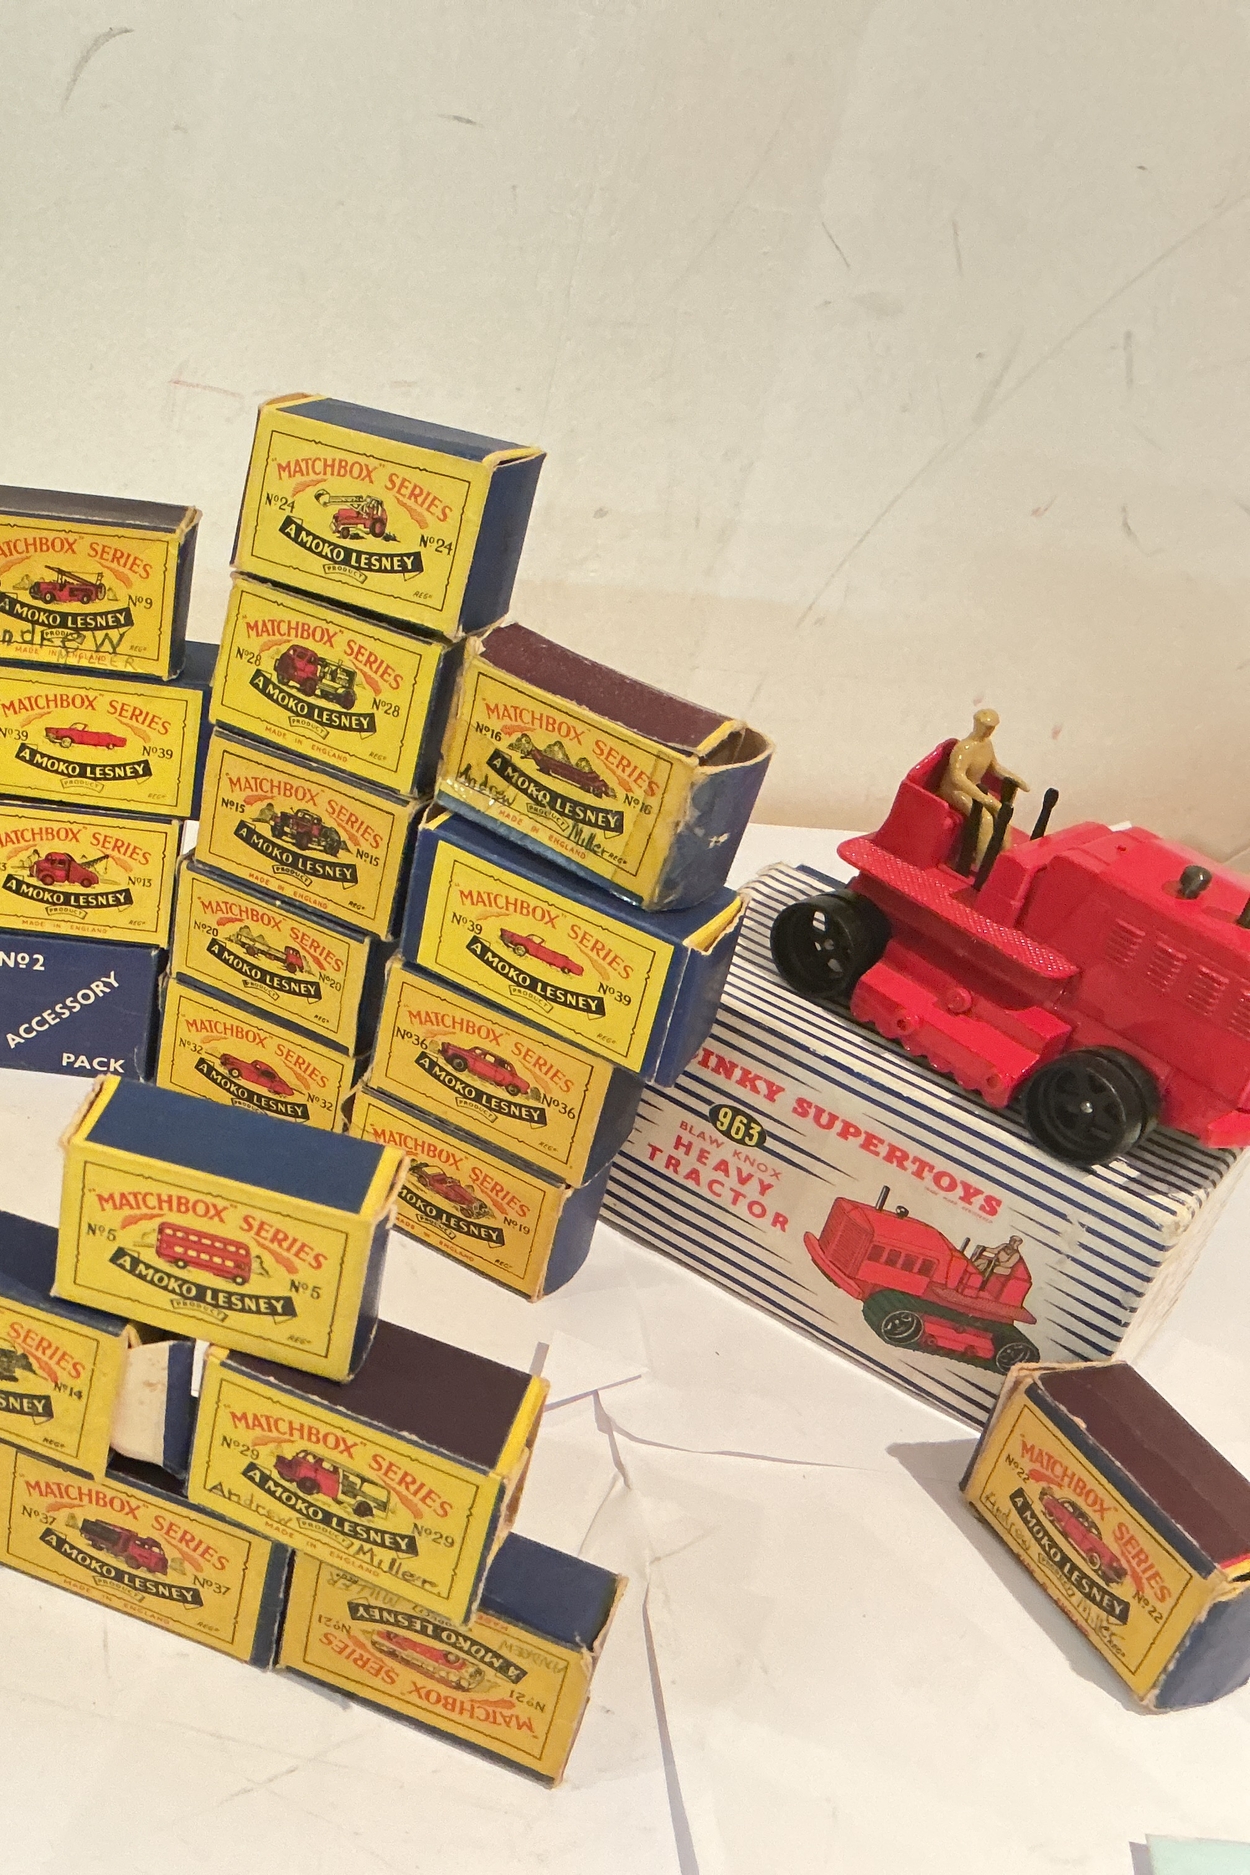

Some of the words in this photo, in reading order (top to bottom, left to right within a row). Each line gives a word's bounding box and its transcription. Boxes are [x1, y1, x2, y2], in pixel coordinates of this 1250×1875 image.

[388, 469, 453, 522] SERIES
[14, 604, 60, 625] MOKO
[67, 613, 126, 628] LESNEY
[109, 700, 171, 736] SERIES
[266, 685, 307, 715] MOKO
[315, 707, 371, 730] LESNEY
[504, 766, 549, 802] MOKO
[556, 799, 619, 828] LESNEY
[90, 833, 152, 865] SERIES
[324, 799, 383, 848] SERIES
[224, 953, 262, 983] MOKO
[264, 977, 319, 998] LESNEY
[485, 953, 533, 988] MOKO
[537, 979, 600, 1012] LESNEY
[5, 972, 120, 1048] ACCESSORY
[62, 1052, 124, 1073] PACK
[275, 1043, 329, 1089] SERIES
[513, 1041, 574, 1092] SERIES
[679, 1119, 725, 1147] BLAW
[732, 1150, 782, 1180] KNOX
[692, 1047, 785, 1103] INKY
[792, 1097, 1003, 1217] SUPERTOYS
[715, 1108, 761, 1146] 963
[469, 1158, 530, 1218] SERIES
[648, 1145, 790, 1233] TRACTOR
[674, 1135, 774, 1196] HEAVY
[441, 1216, 500, 1242] LESNEY
[136, 1262, 196, 1296] MOKO
[206, 1289, 284, 1313] LESNEY
[10, 1322, 85, 1379] SERIES
[369, 1454, 452, 1518] SERIES
[62, 1544, 115, 1577] MOKO
[124, 1574, 194, 1601] LESNEY
[1113, 1522, 1172, 1603] SERIES
[357, 1607, 433, 1636] LESNEY
[319, 1632, 399, 1684] SERIES
[442, 1631, 500, 1668] MOKO
